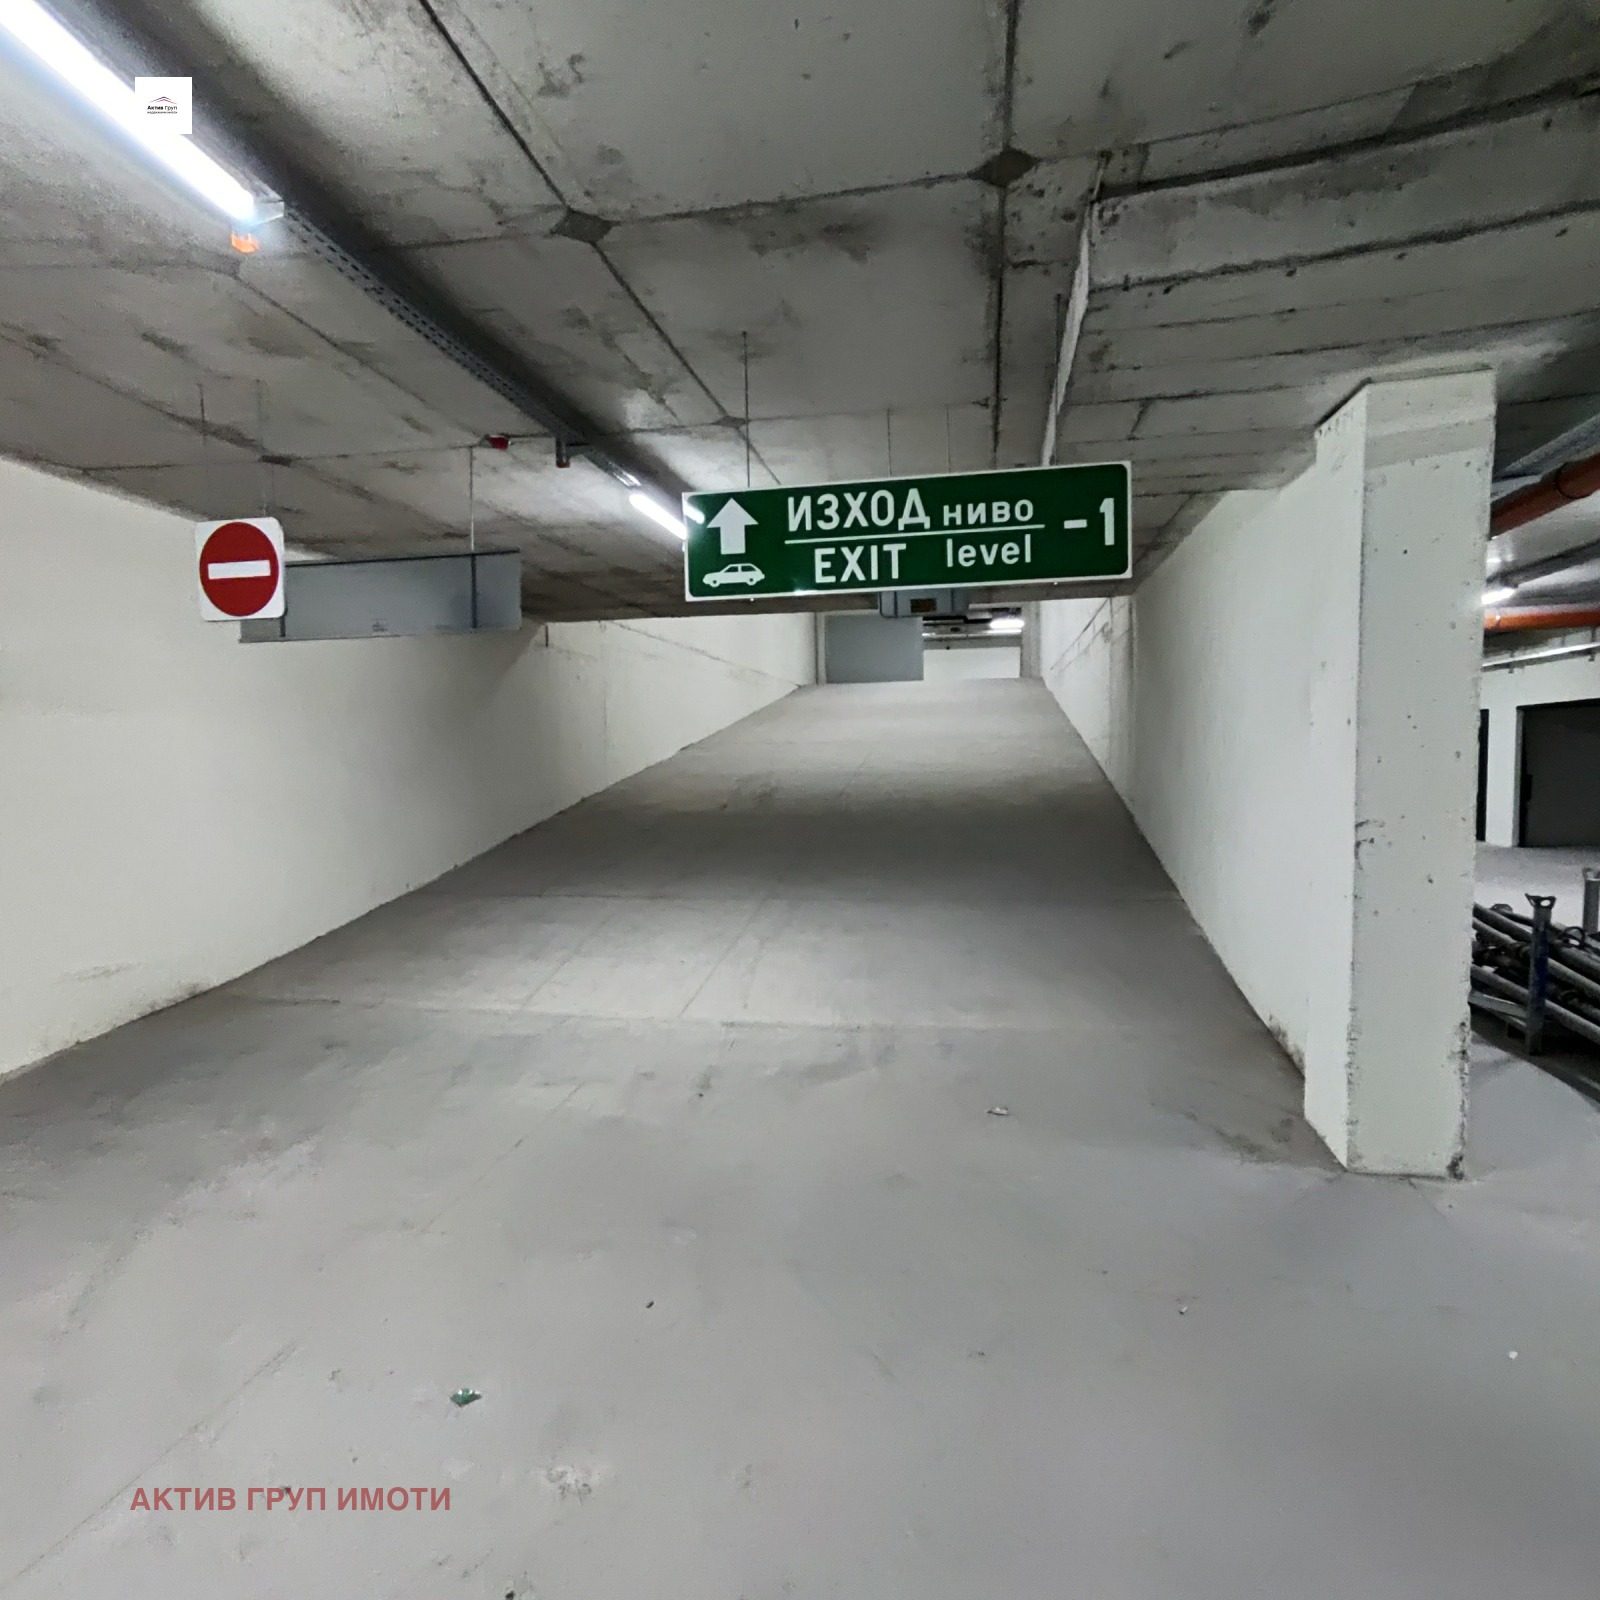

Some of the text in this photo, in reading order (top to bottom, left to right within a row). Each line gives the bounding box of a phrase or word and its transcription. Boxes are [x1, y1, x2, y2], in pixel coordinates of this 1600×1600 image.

[788, 488, 1034, 532] ИЗХОД ниво
[1063, 497, 1116, 547] -1
[814, 533, 1032, 584] EXIT level
